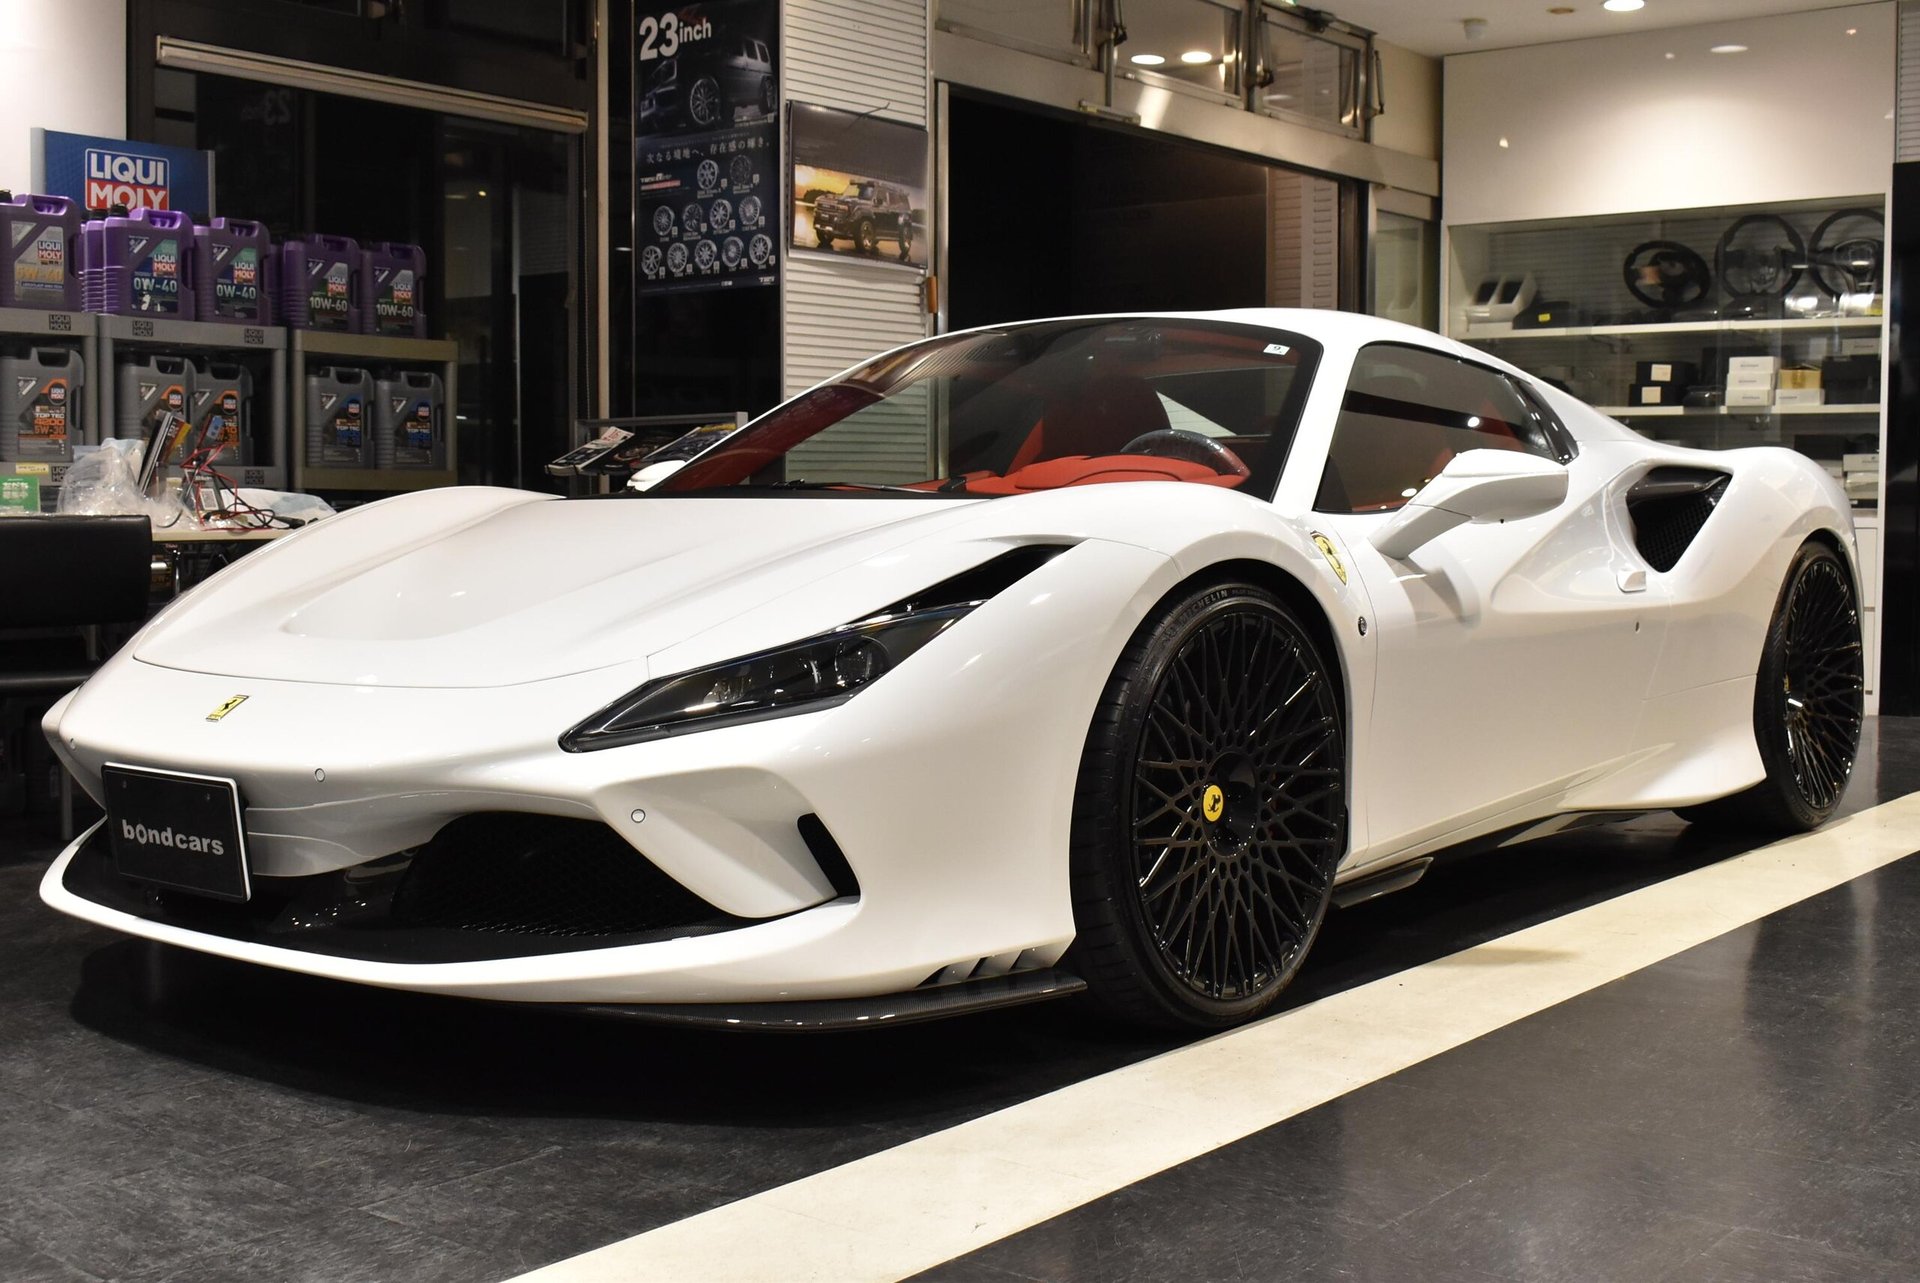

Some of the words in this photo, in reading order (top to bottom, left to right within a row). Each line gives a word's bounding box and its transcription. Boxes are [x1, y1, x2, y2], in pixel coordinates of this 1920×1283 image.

[90, 152, 164, 186] LIQUI
[90, 182, 167, 211] MOLY
[38, 241, 61, 250] LIQUI
[38, 250, 63, 260] MOLY
[153, 254, 176, 263] LIQUI
[154, 262, 177, 272] MOLY
[216, 284, 257, 299] 0W-40
[309, 296, 348, 312] 10W-60
[376, 304, 414, 318] 10W-60
